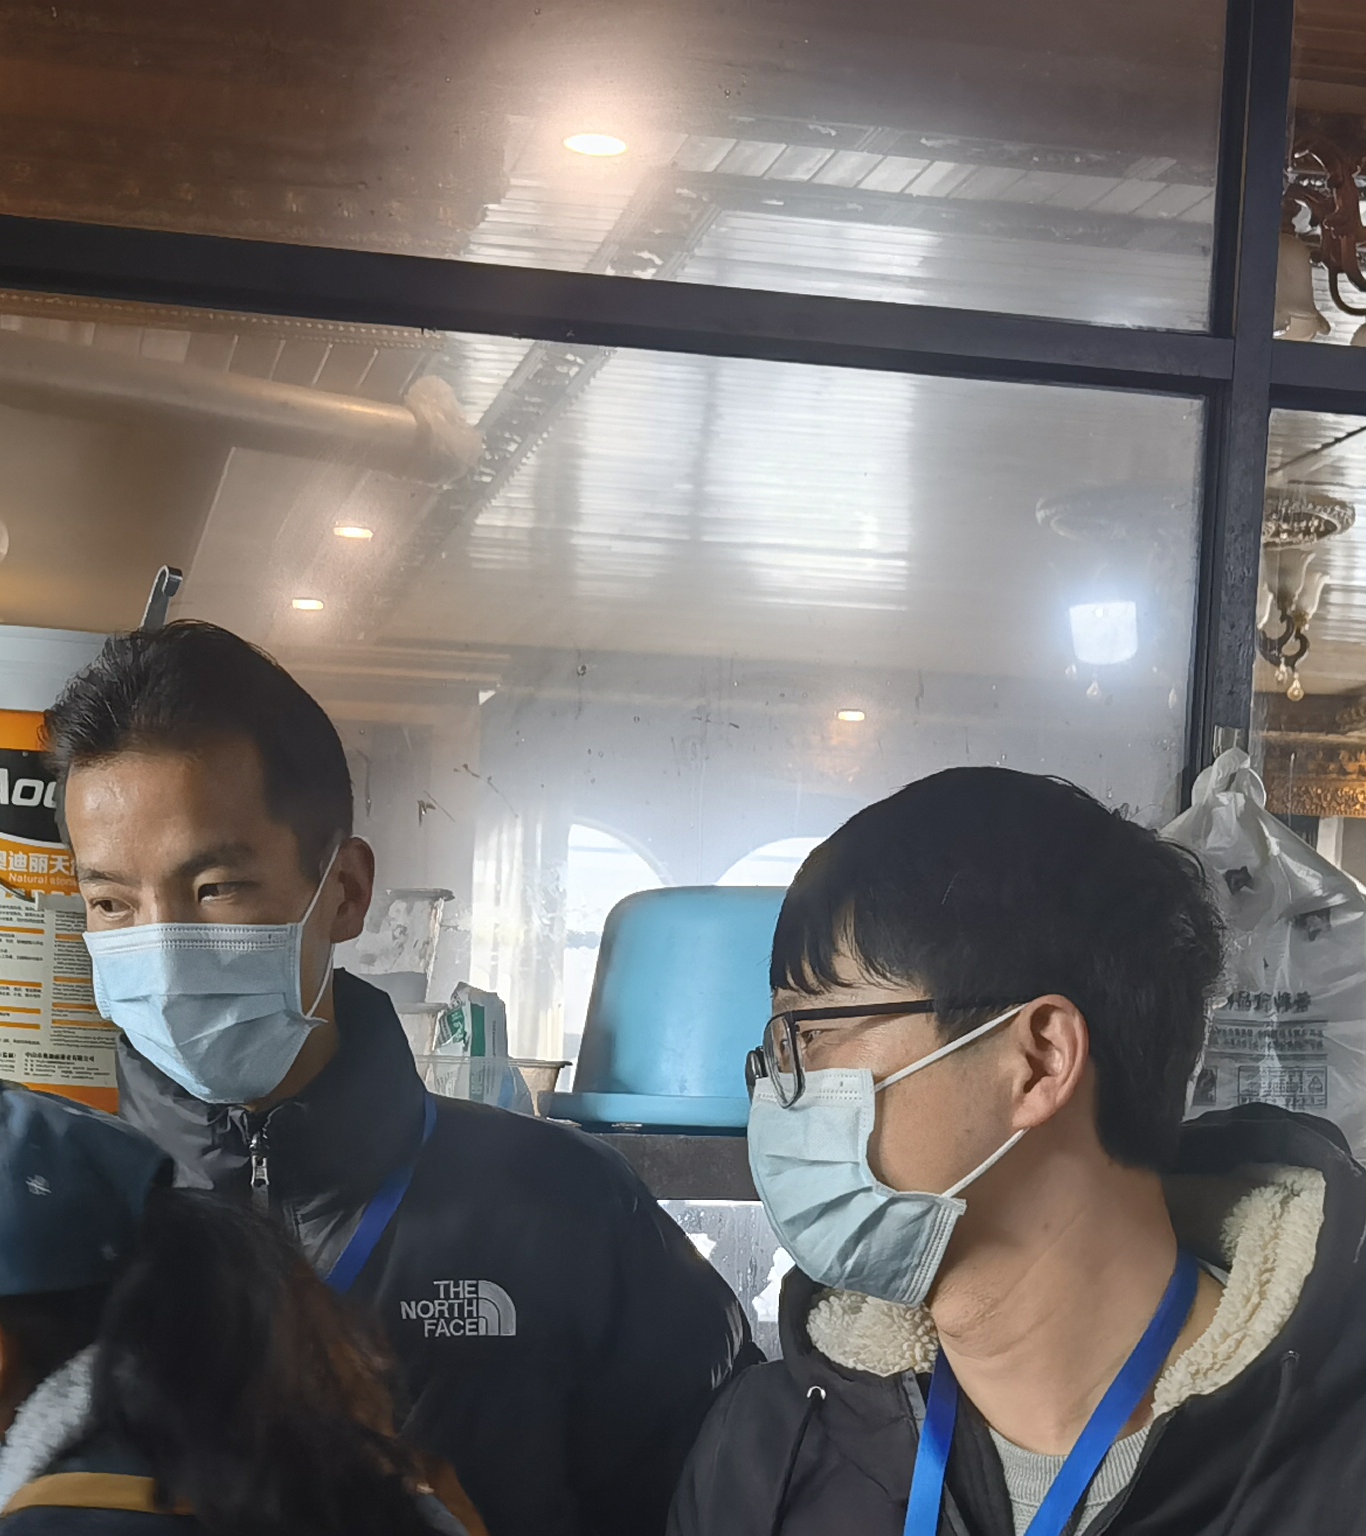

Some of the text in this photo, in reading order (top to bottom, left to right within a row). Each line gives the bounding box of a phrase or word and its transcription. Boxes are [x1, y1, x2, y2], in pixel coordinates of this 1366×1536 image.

[8, 872, 48, 884] Natural
[433, 1280, 478, 1299] THE
[400, 1299, 478, 1320] NORTH
[423, 1318, 478, 1338] FACE
